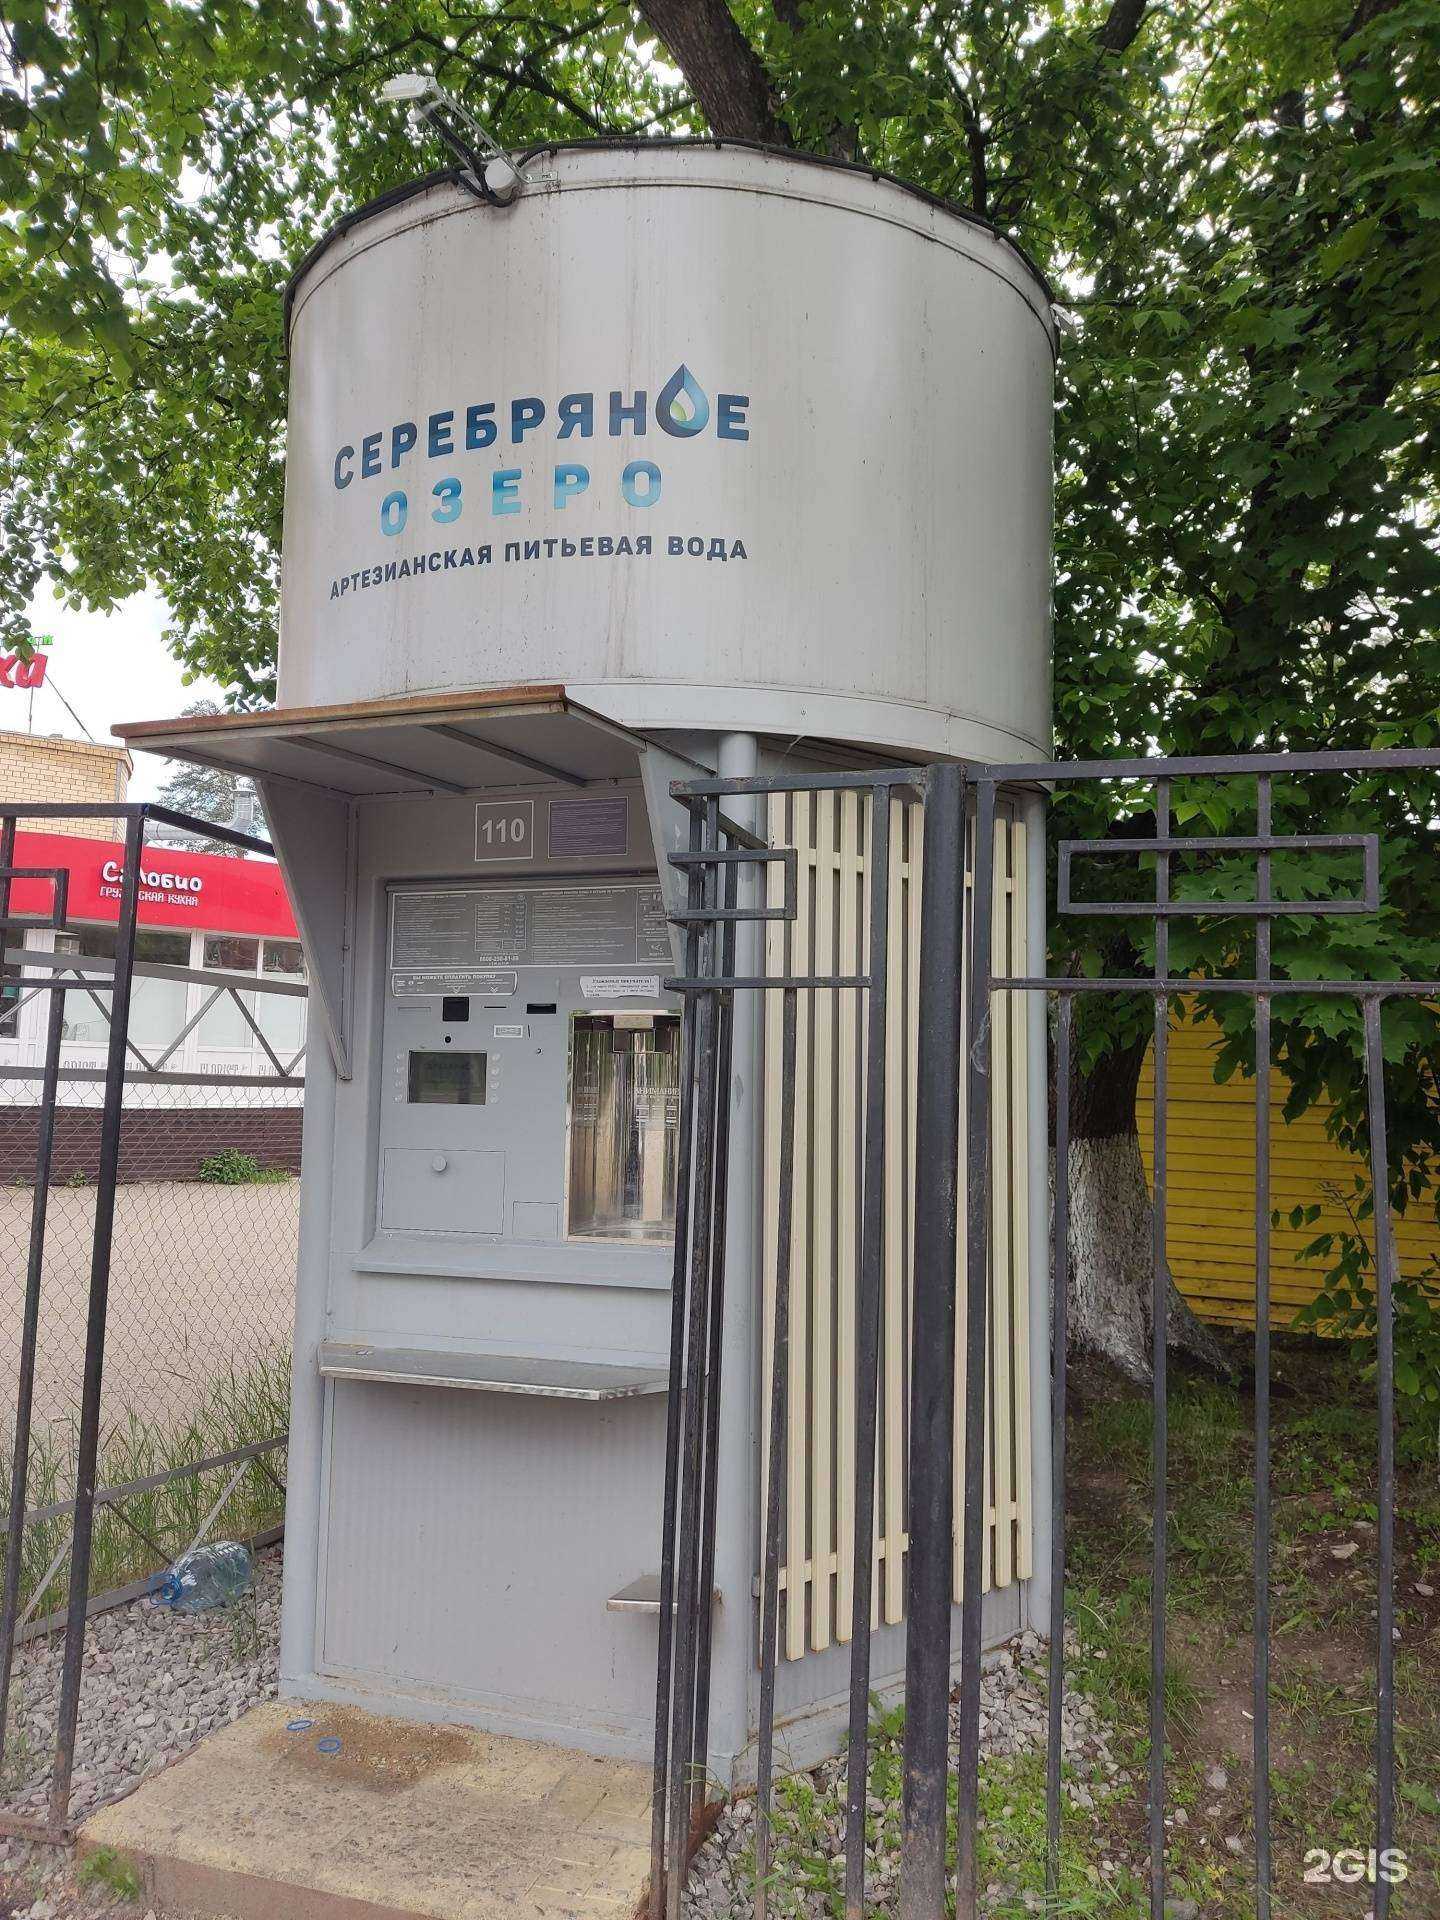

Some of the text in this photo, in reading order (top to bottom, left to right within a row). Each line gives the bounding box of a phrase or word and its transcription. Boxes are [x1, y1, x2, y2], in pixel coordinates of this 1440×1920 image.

[333, 363, 750, 490] СЕРЕБРЯНОЕ
[380, 460, 663, 538] ОЗЕРО
[330, 535, 748, 600] АРТЕЗИАНСКАЯ ПИТЬЕВАЯ ВОДА
[481, 818, 525, 843] 110
